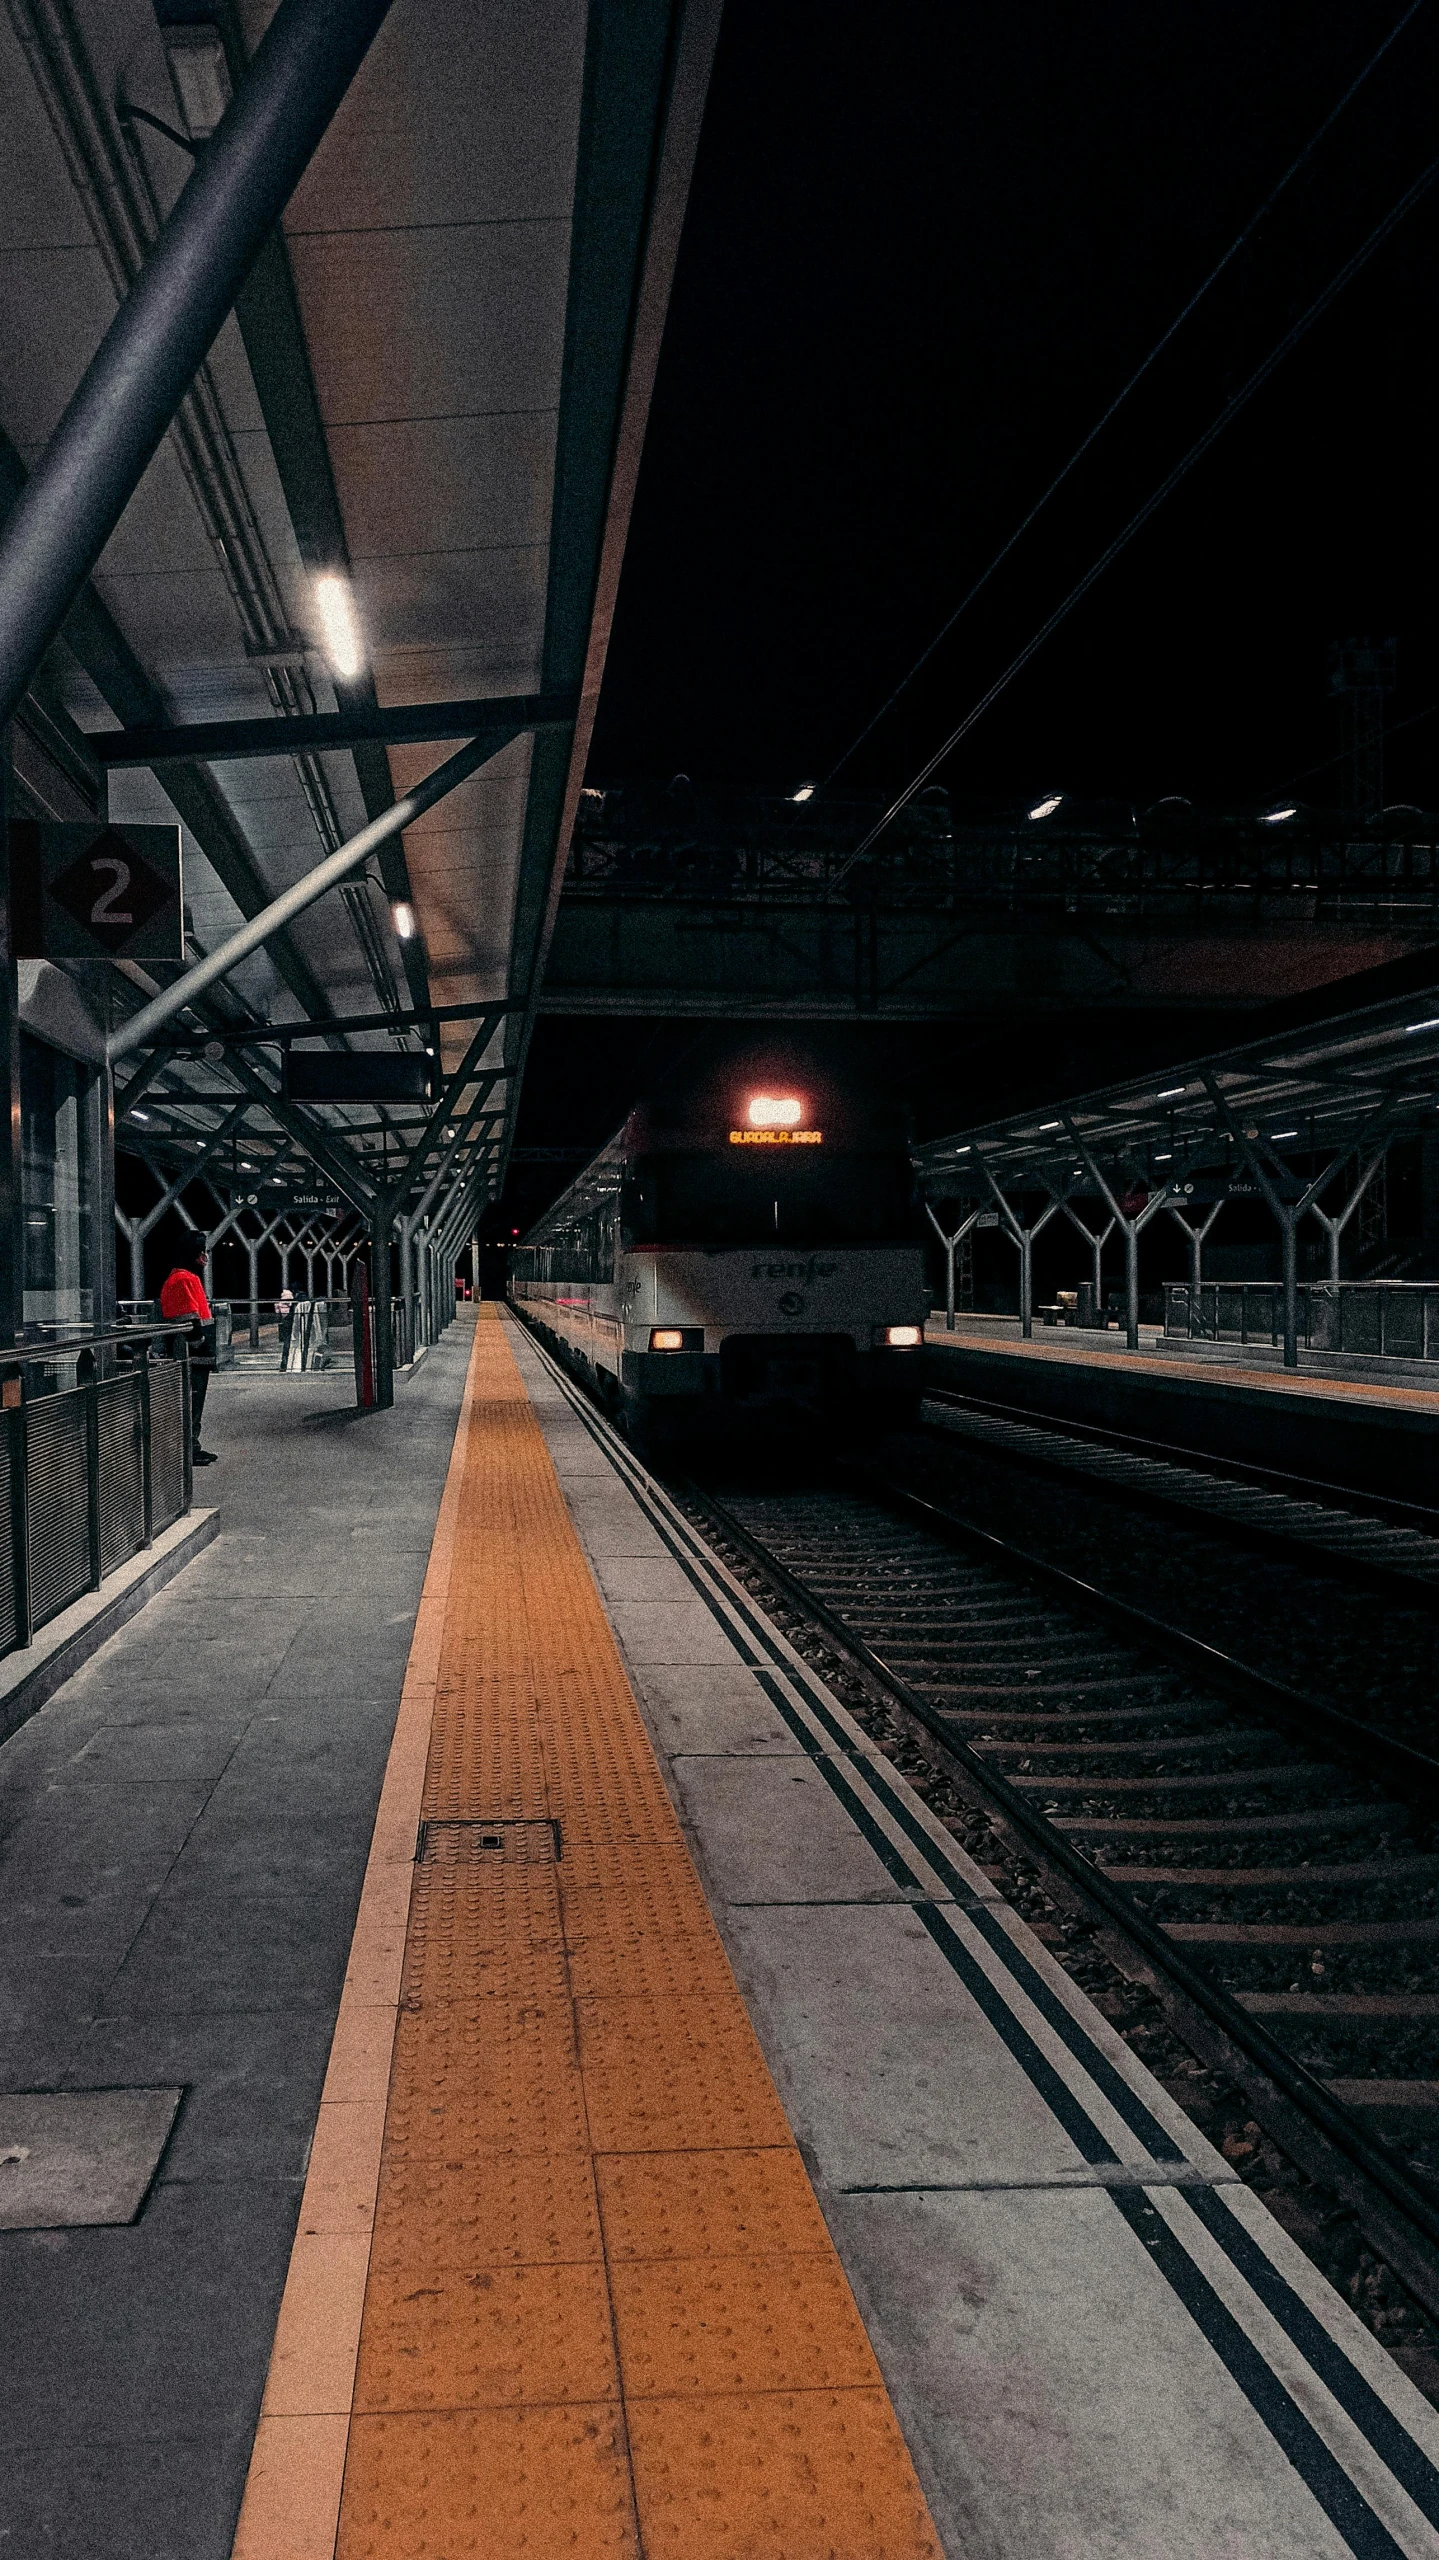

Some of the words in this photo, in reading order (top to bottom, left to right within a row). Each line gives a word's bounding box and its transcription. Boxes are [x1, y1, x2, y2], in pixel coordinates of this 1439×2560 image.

[90, 858, 133, 923] 2
[729, 1131, 822, 1144] GUADALAJARA
[1228, 1184, 1252, 1192] Salida
[293, 1195, 318, 1204] Salida
[326, 1196, 340, 1204] Exit
[752, 1255, 837, 1285] renfe
